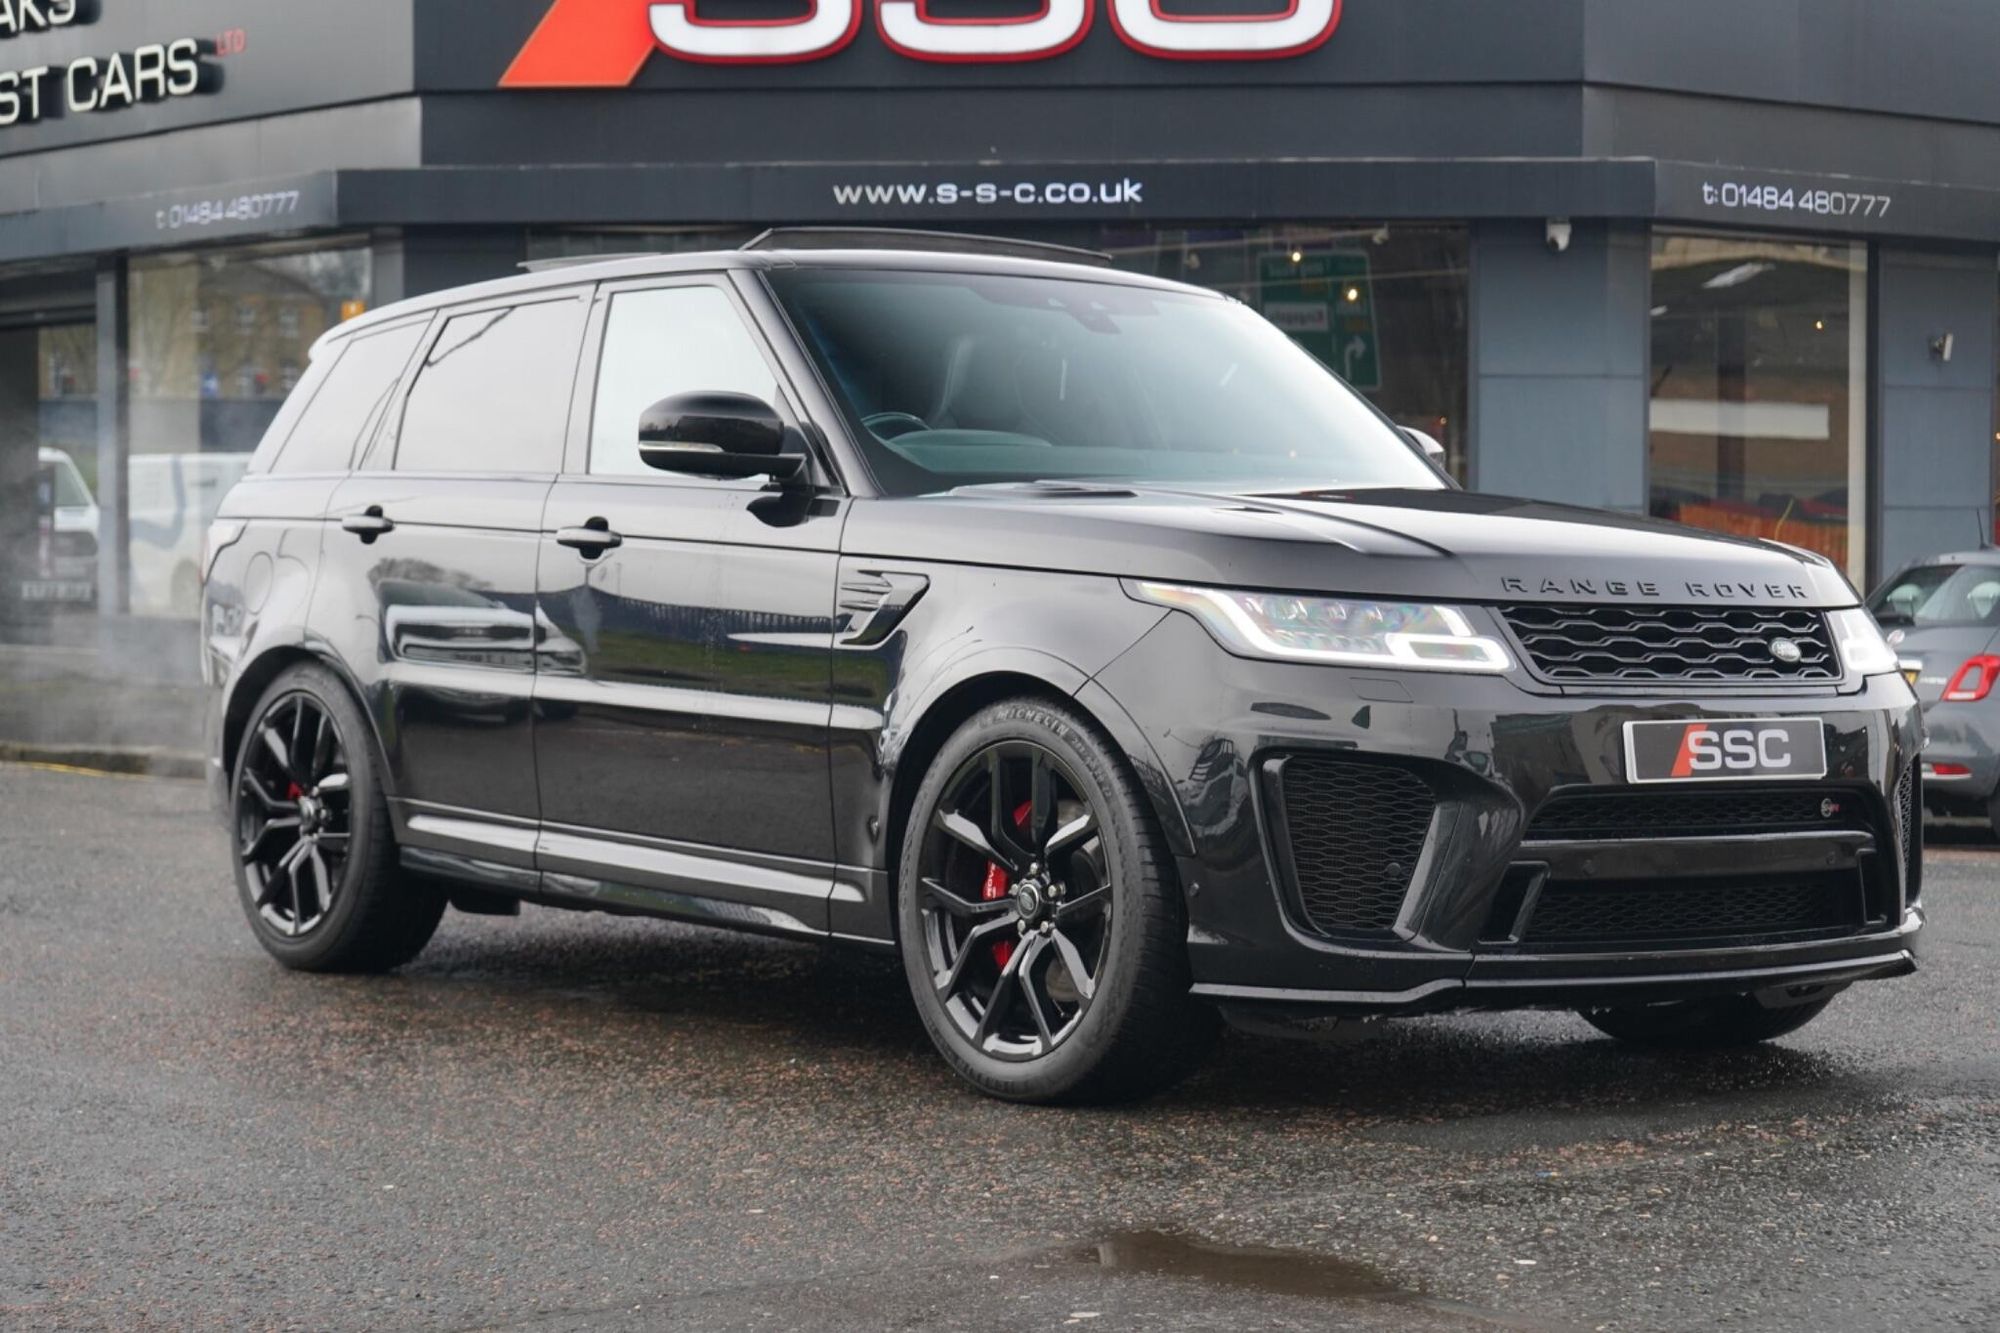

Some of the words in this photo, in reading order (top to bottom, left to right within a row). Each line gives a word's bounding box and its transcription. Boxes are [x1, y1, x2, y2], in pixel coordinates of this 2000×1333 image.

[67, 37, 198, 113] CARS
[216, 28, 246, 57] LTD
[832, 177, 1143, 204] www.s-s-c.co.uk
[1501, 577, 1660, 597] RANGE
[1685, 581, 1808, 599] ROVER
[997, 708, 1070, 735] MICHELIN
[1687, 728, 1792, 770] SSC
